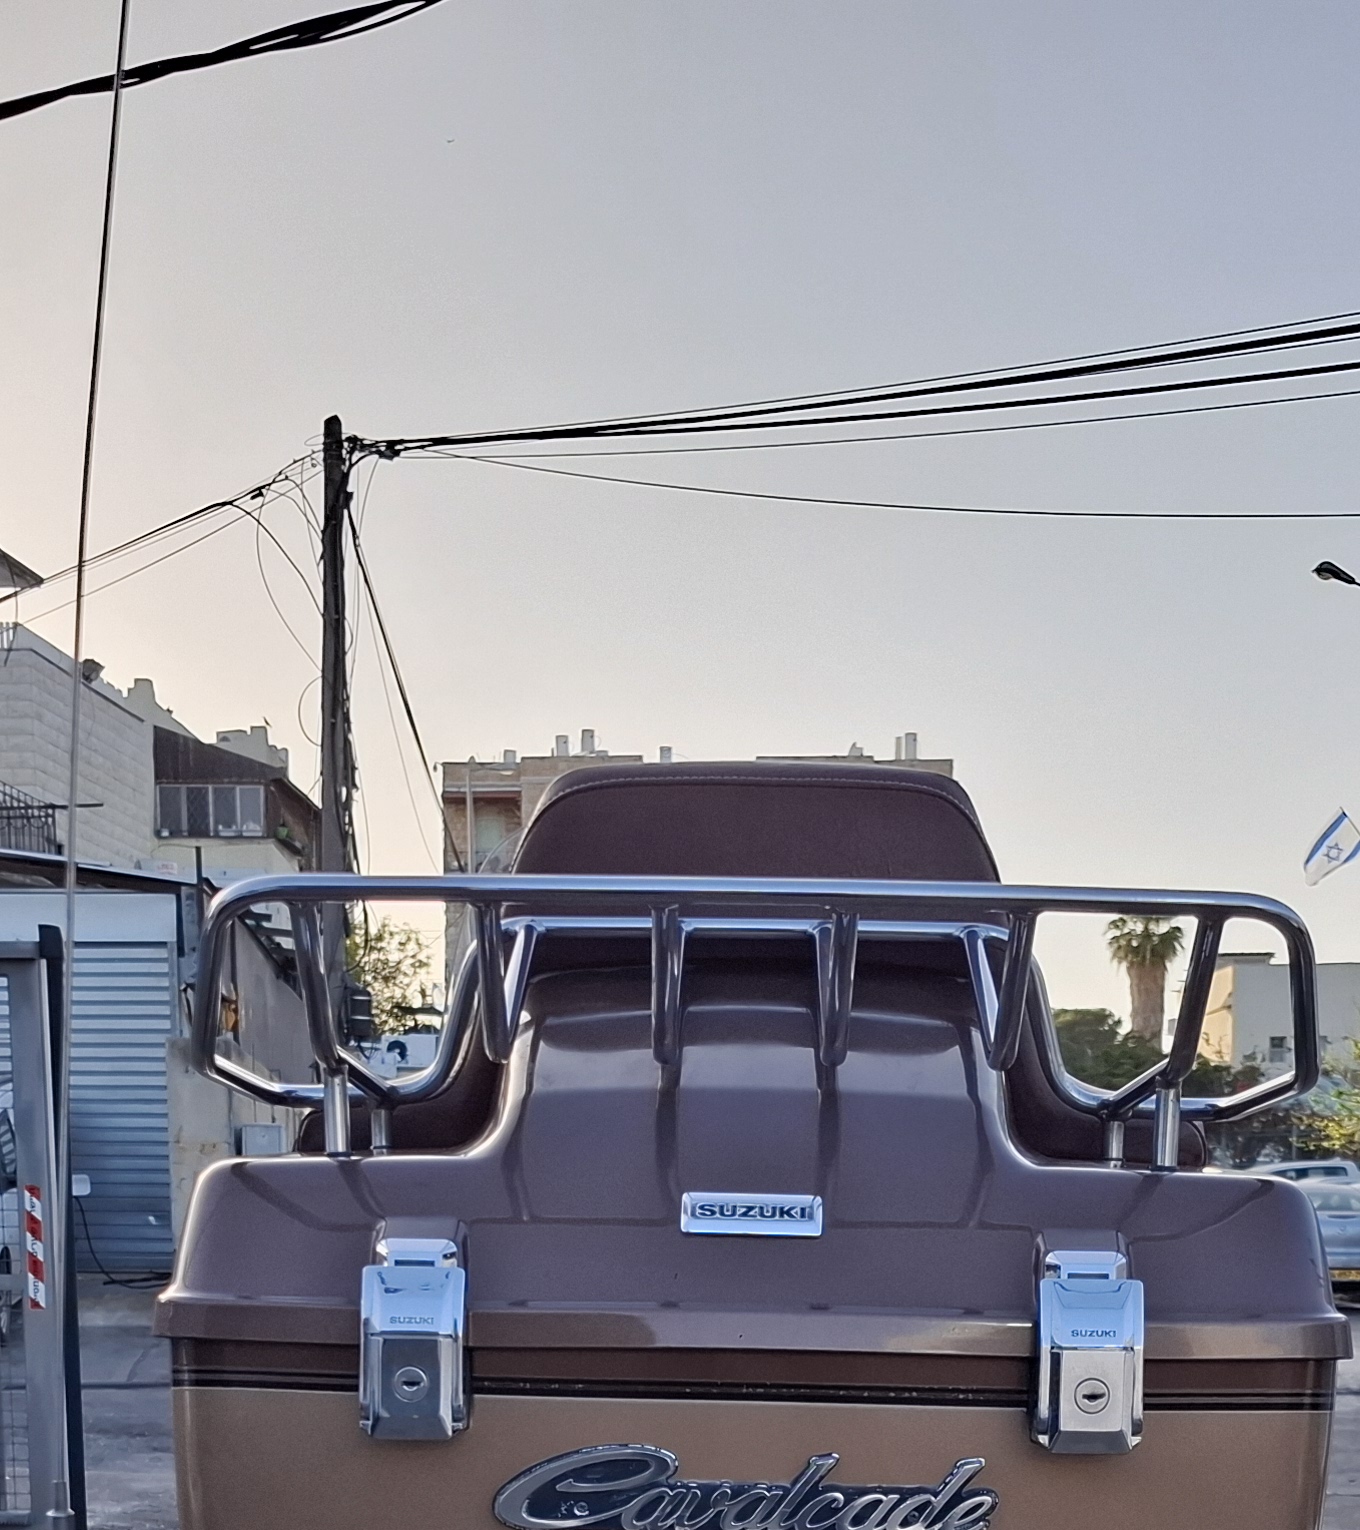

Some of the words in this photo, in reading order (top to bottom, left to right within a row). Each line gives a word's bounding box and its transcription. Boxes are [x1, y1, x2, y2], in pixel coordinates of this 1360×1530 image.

[696, 1202, 808, 1219] SUZUKI
[389, 1315, 435, 1326] SUZUKI
[1070, 1328, 1118, 1338] SUZUKI
